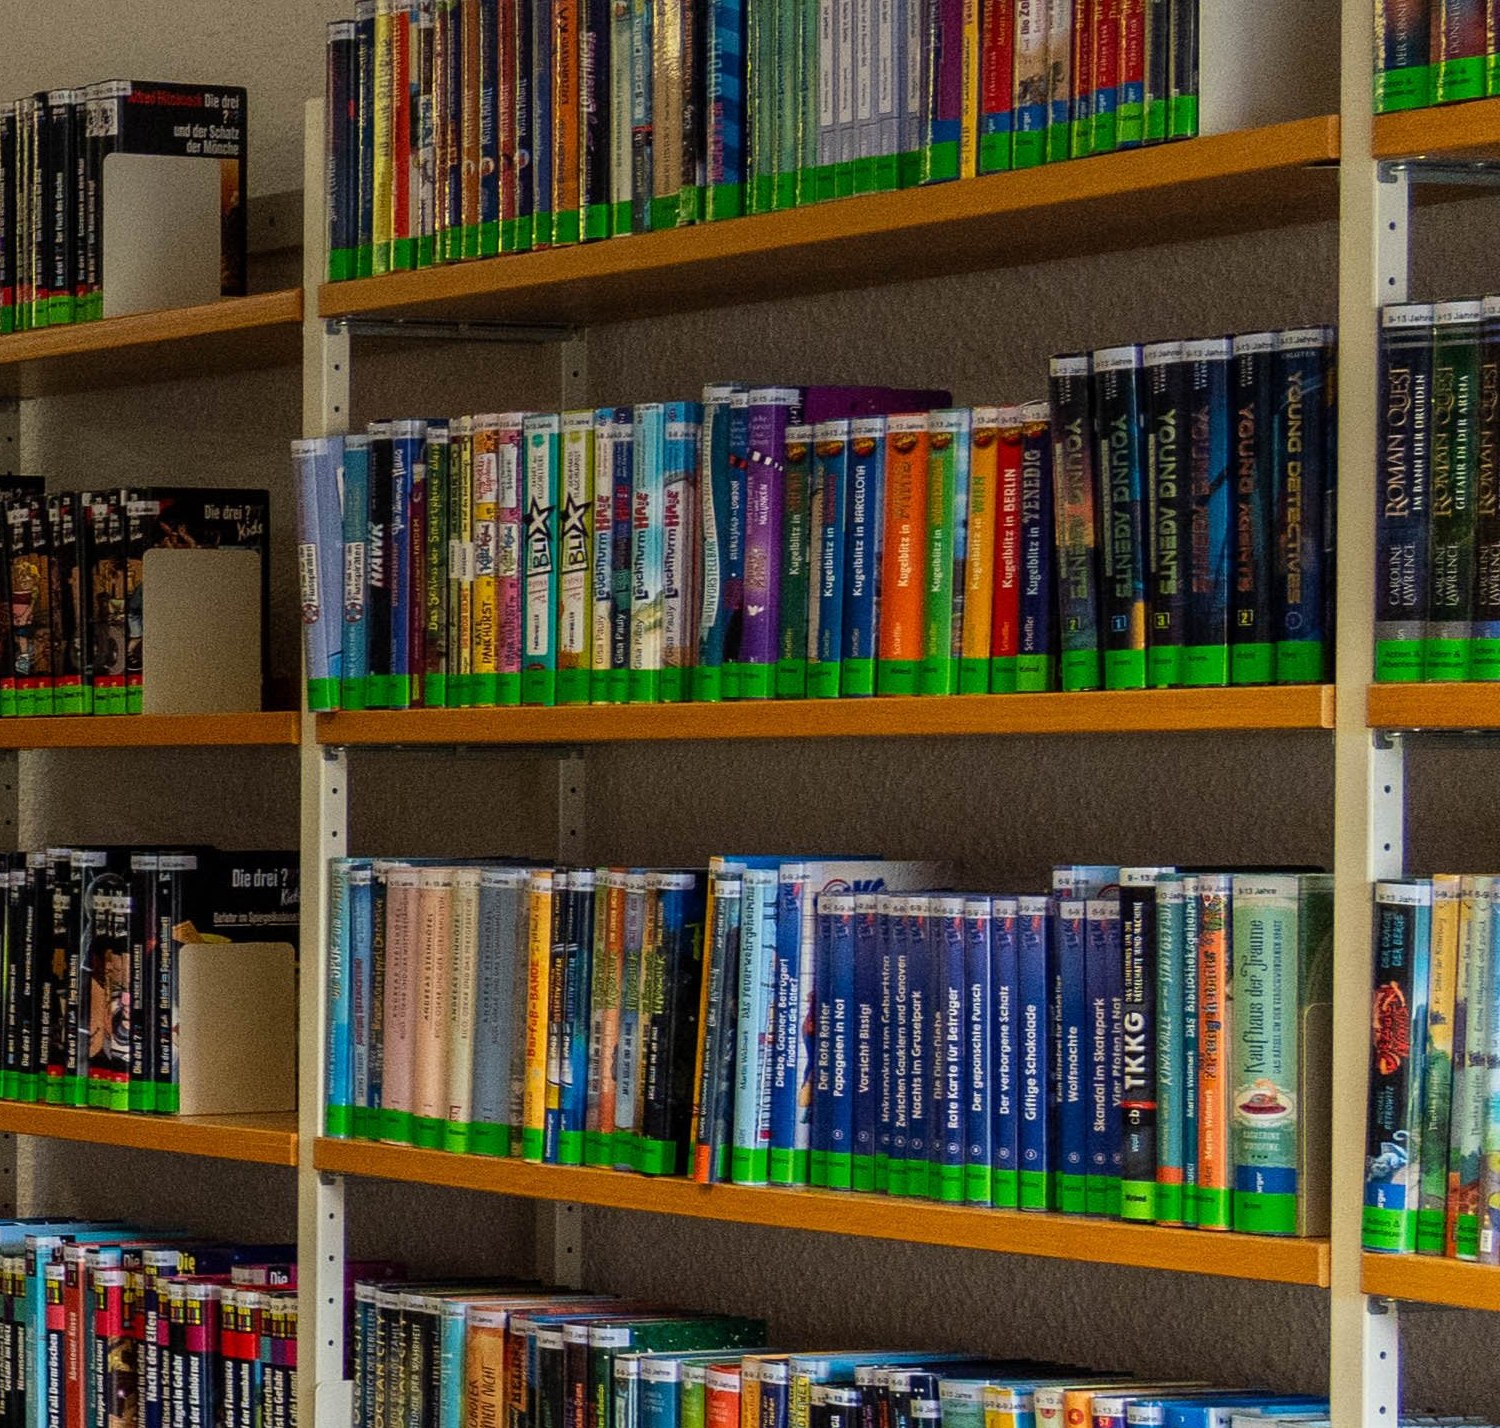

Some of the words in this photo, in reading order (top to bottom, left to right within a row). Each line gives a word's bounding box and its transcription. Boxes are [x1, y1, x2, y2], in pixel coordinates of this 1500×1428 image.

[204, 93, 219, 108] Die
[221, 94, 239, 109] drei
[174, 124, 190, 138] und
[193, 125, 207, 138] der
[209, 125, 239, 140] Schatz
[186, 140, 202, 154] der
[1387, 368, 1410, 426] QUEST
[1414, 374, 1424, 428] DRUIDEN
[1458, 375, 1468, 412] ARENA
[1414, 432, 1424, 455] DER
[1457, 419, 1467, 441] DER
[854, 465, 866, 523] BARCELONA
[1004, 468, 1016, 511] BERLIN
[1023, 450, 1041, 523] VENEDIG
[1385, 434, 1410, 517] ROMAN
[1413, 459, 1423, 492] BANN
[1457, 463, 1466, 509] GEFAHR
[204, 504, 221, 520] Die
[222, 505, 242, 520] drei
[1005, 515, 1015, 526] in
[1413, 496, 1422, 510] IM
[527, 496, 554, 574] BLIX
[562, 493, 591, 570] BLIX
[855, 526, 864, 537] in
[1030, 526, 1040, 538] in
[853, 541, 865, 596] Kugelblitz
[1003, 530, 1014, 588] Kugelblitz
[1027, 541, 1039, 595] Kugelblitz
[1389, 546, 1401, 606] CAROLINE
[1404, 545, 1416, 606] LAWRENCE
[615, 613, 626, 639] Pauly
[836, 998, 845, 1018] Not
[950, 987, 960, 1040] Betrüger
[973, 983, 983, 1021] Punsch
[1000, 985, 1010, 1022] Schatz
[835, 1021, 844, 1032] in
[1026, 1004, 1037, 1074] Schokolade
[833, 1034, 845, 1097] Papageien
[1000, 1024, 1011, 1090] verborgene
[1068, 1026, 1078, 1102] Wolfsnächte
[1124, 1012, 1146, 1090] TKKG
[949, 1065, 958, 1098] Karte
[972, 1092, 981, 1111] Der
[1025, 1078, 1036, 1121] Giftige
[948, 1101, 957, 1128] Rote
[1000, 1094, 1009, 1114] Der
